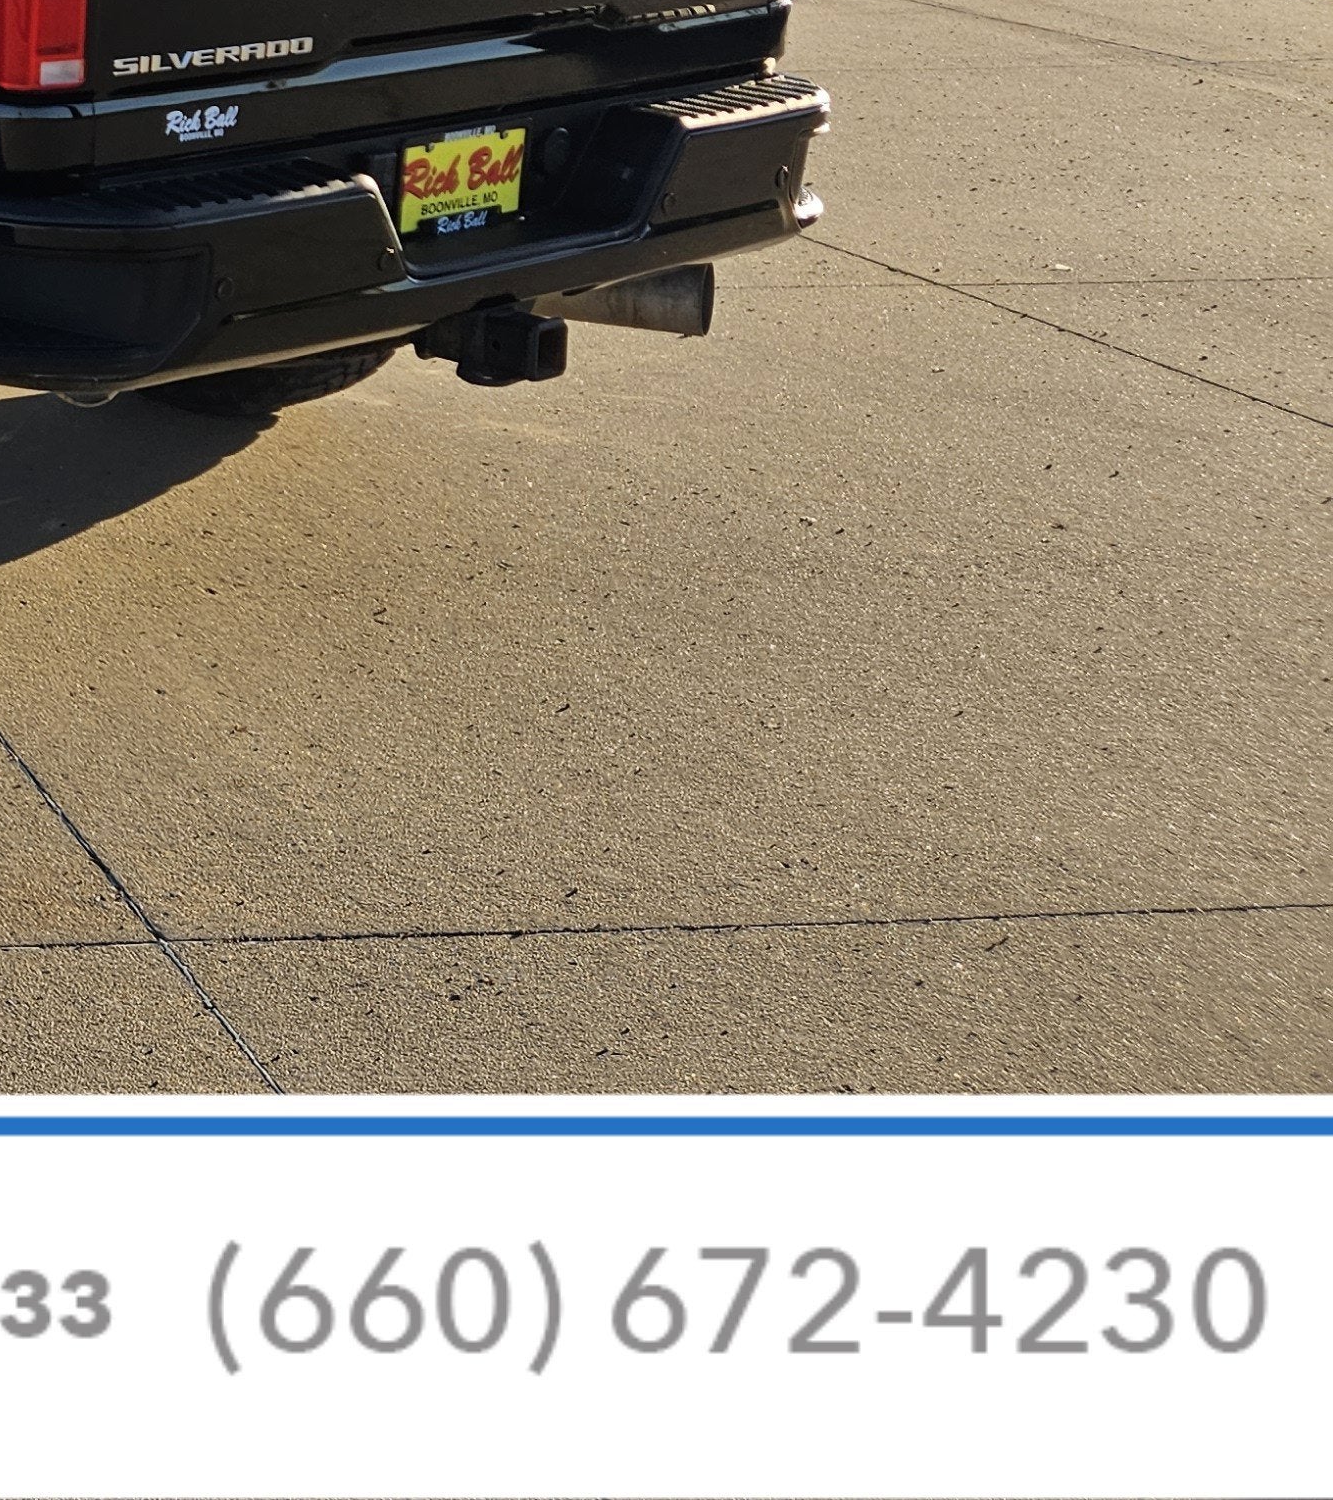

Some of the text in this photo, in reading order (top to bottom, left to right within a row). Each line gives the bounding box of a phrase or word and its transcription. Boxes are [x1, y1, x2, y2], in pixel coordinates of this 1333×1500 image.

[112, 37, 314, 77] SILVERADO
[165, 105, 239, 136] Rick Ball
[403, 143, 524, 200] Rick Ball
[483, 190, 498, 203] MO
[437, 210, 488, 235] Rick Ball
